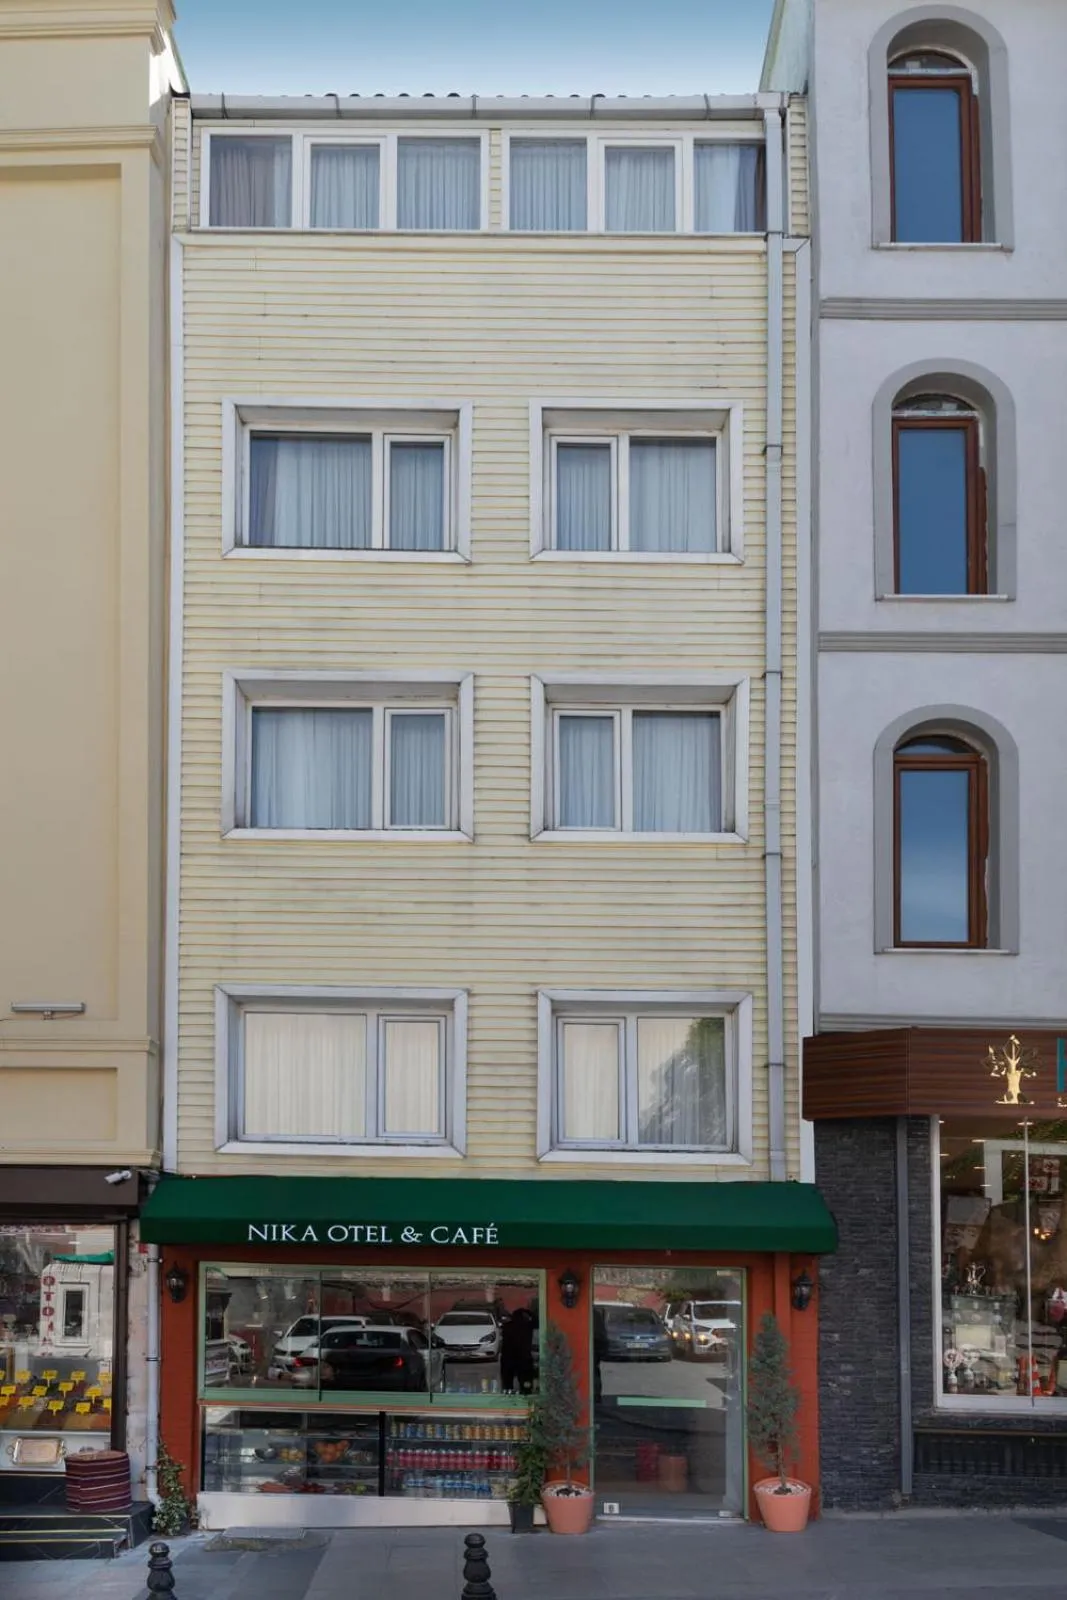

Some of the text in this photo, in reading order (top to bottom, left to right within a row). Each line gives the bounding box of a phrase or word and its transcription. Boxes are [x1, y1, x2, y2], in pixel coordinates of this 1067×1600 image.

[248, 1222, 499, 1244] NIKA OTEL & CAFÉ
